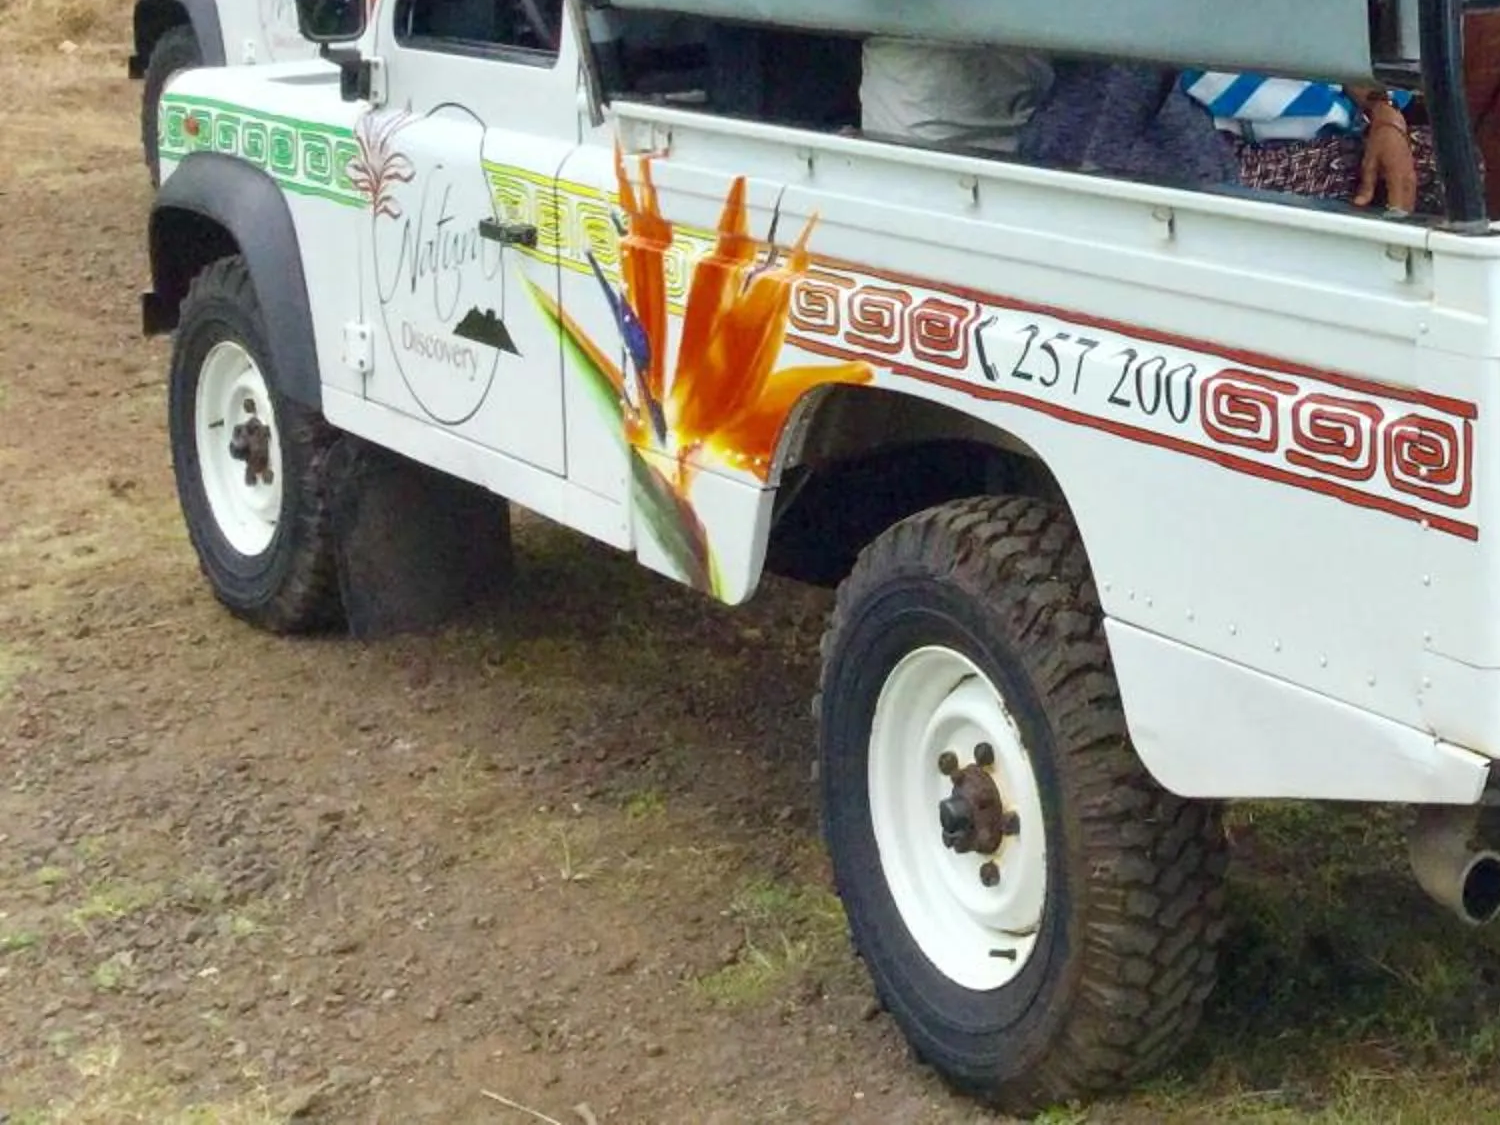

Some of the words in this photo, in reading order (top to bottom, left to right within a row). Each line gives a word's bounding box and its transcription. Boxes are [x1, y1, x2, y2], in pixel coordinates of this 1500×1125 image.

[382, 162, 503, 324] Natur
[402, 321, 478, 382] Discovery
[1011, 323, 1100, 395] 257
[1107, 348, 1197, 424] 200
